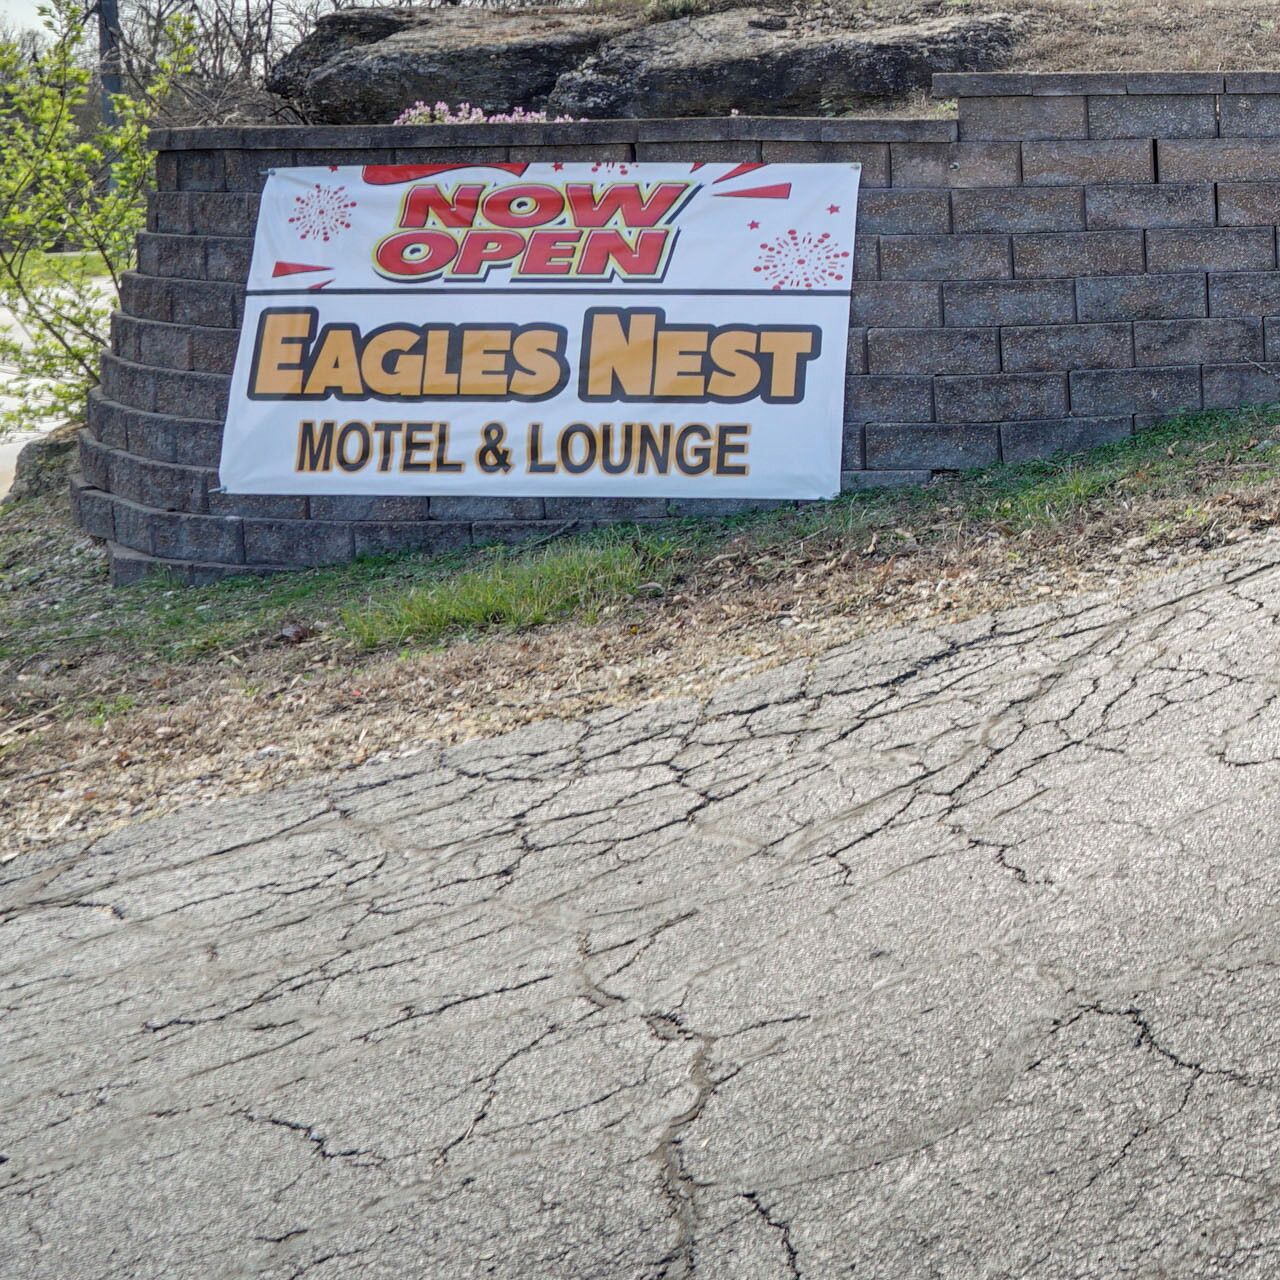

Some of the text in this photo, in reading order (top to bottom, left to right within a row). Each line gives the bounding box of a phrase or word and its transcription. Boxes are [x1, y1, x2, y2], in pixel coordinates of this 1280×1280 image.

[398, 181, 703, 229] NOW
[371, 228, 681, 283] OPEN
[247, 306, 822, 404] EAGLES NEST
[296, 420, 752, 477] MOTEL & LOUNGE
